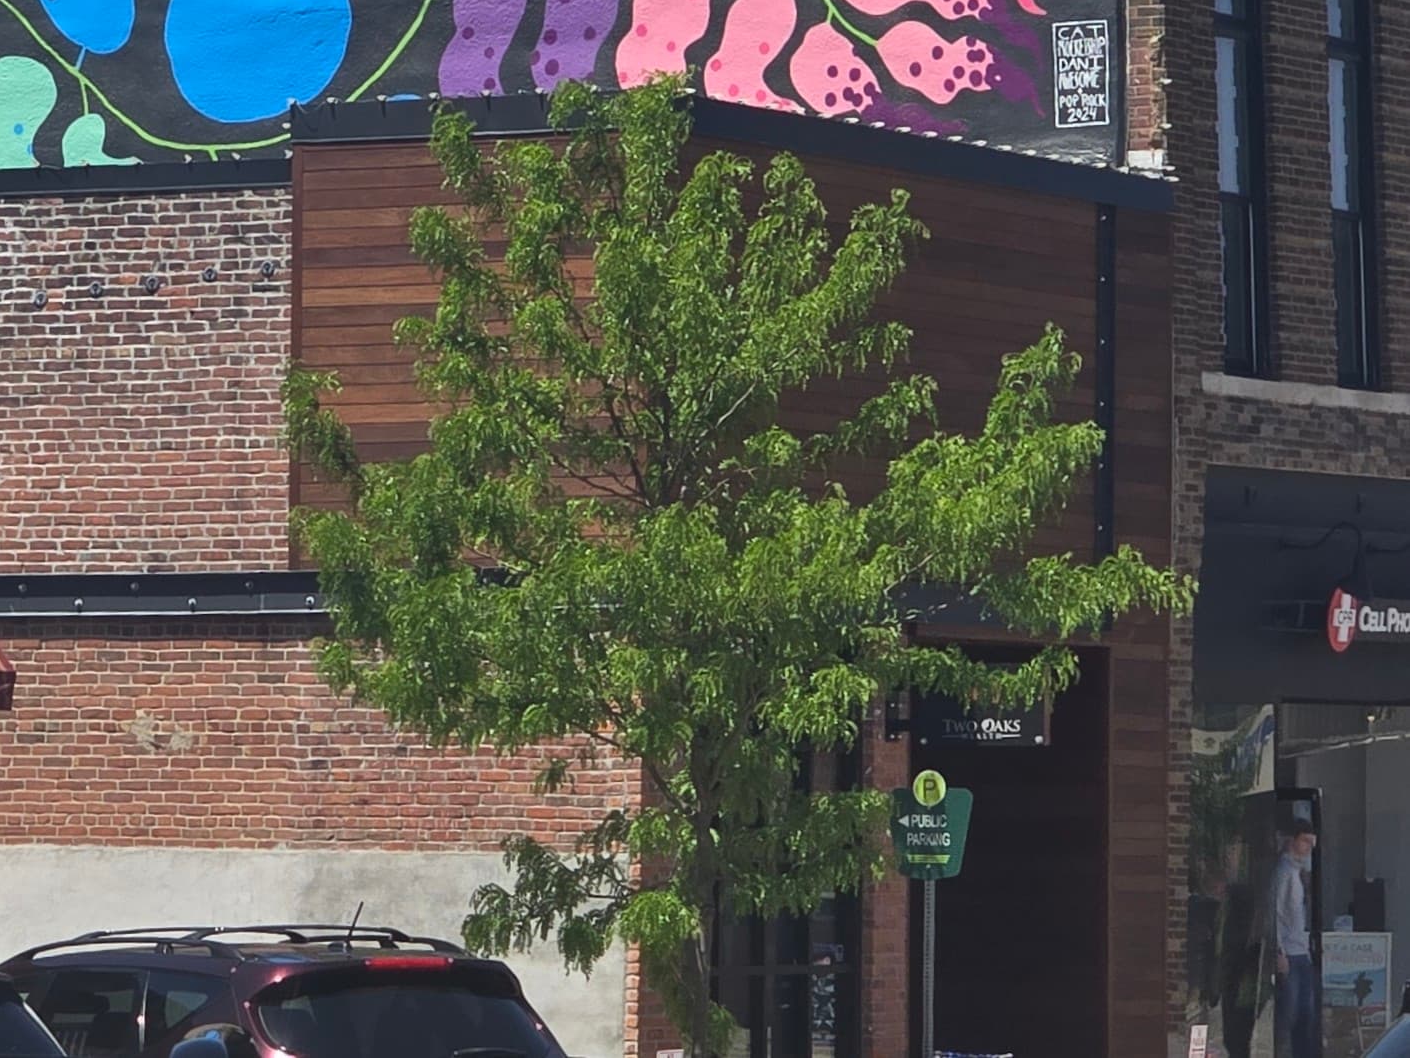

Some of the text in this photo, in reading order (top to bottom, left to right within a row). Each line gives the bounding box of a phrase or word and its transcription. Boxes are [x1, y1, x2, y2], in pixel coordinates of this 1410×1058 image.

[1057, 25, 1104, 39] CAT
[1058, 55, 1104, 72] DANI
[1059, 93, 1106, 109] POP ROCK
[1067, 108, 1098, 122] 2024
[1358, 605, 1387, 632] CELL
[941, 717, 1022, 733] TWO OAKS
[923, 779, 937, 800] P
[910, 814, 948, 828] PUBLIC
[906, 832, 951, 847] PARKING
